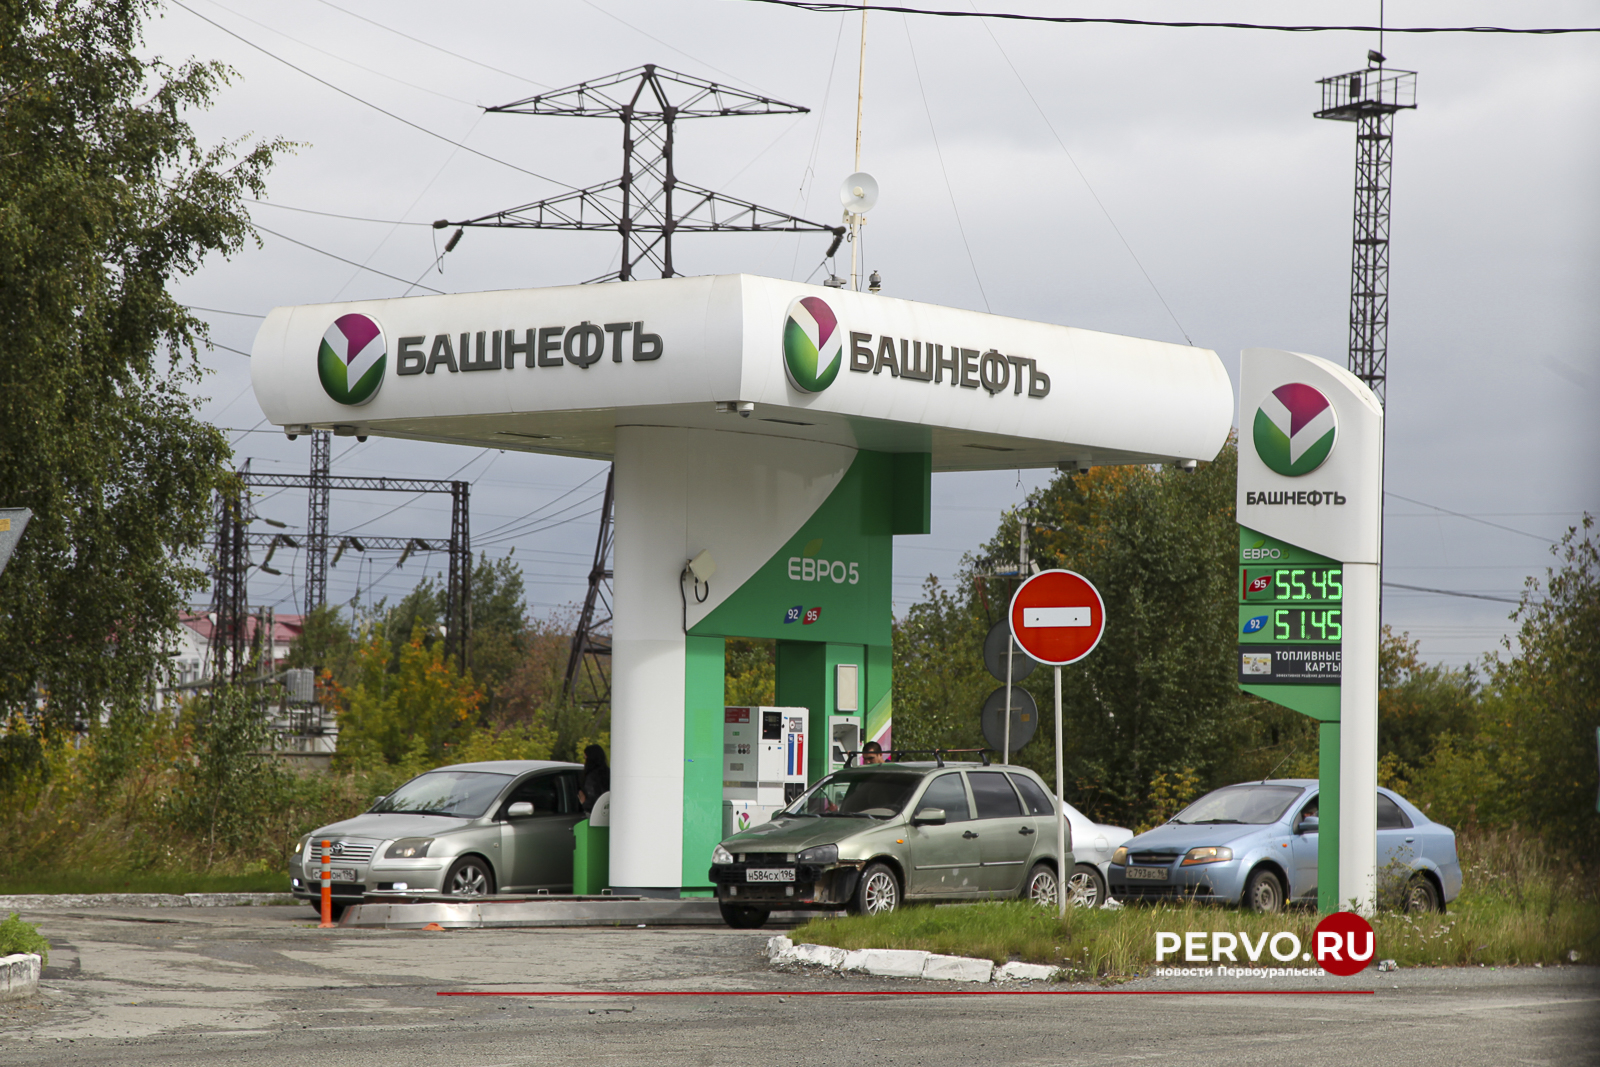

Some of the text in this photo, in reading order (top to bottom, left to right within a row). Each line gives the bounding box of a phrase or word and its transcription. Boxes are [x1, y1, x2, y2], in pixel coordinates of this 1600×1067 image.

[396, 320, 663, 376] БАШНЕФТЬ
[849, 330, 1051, 398] БАШНЕФТЬ
[1246, 490, 1346, 506] БАШНЕФТЬ
[1254, 569, 1343, 600] 95 55.45
[788, 609, 798, 619] 92
[807, 611, 817, 621] 95
[1250, 610, 1342, 640] 92 51.45
[1276, 651, 1341, 661] ТОПЛИВНЫЕ
[1305, 662, 1341, 671] КАРТЫ
[748, 870, 779, 880] Н584СХ
